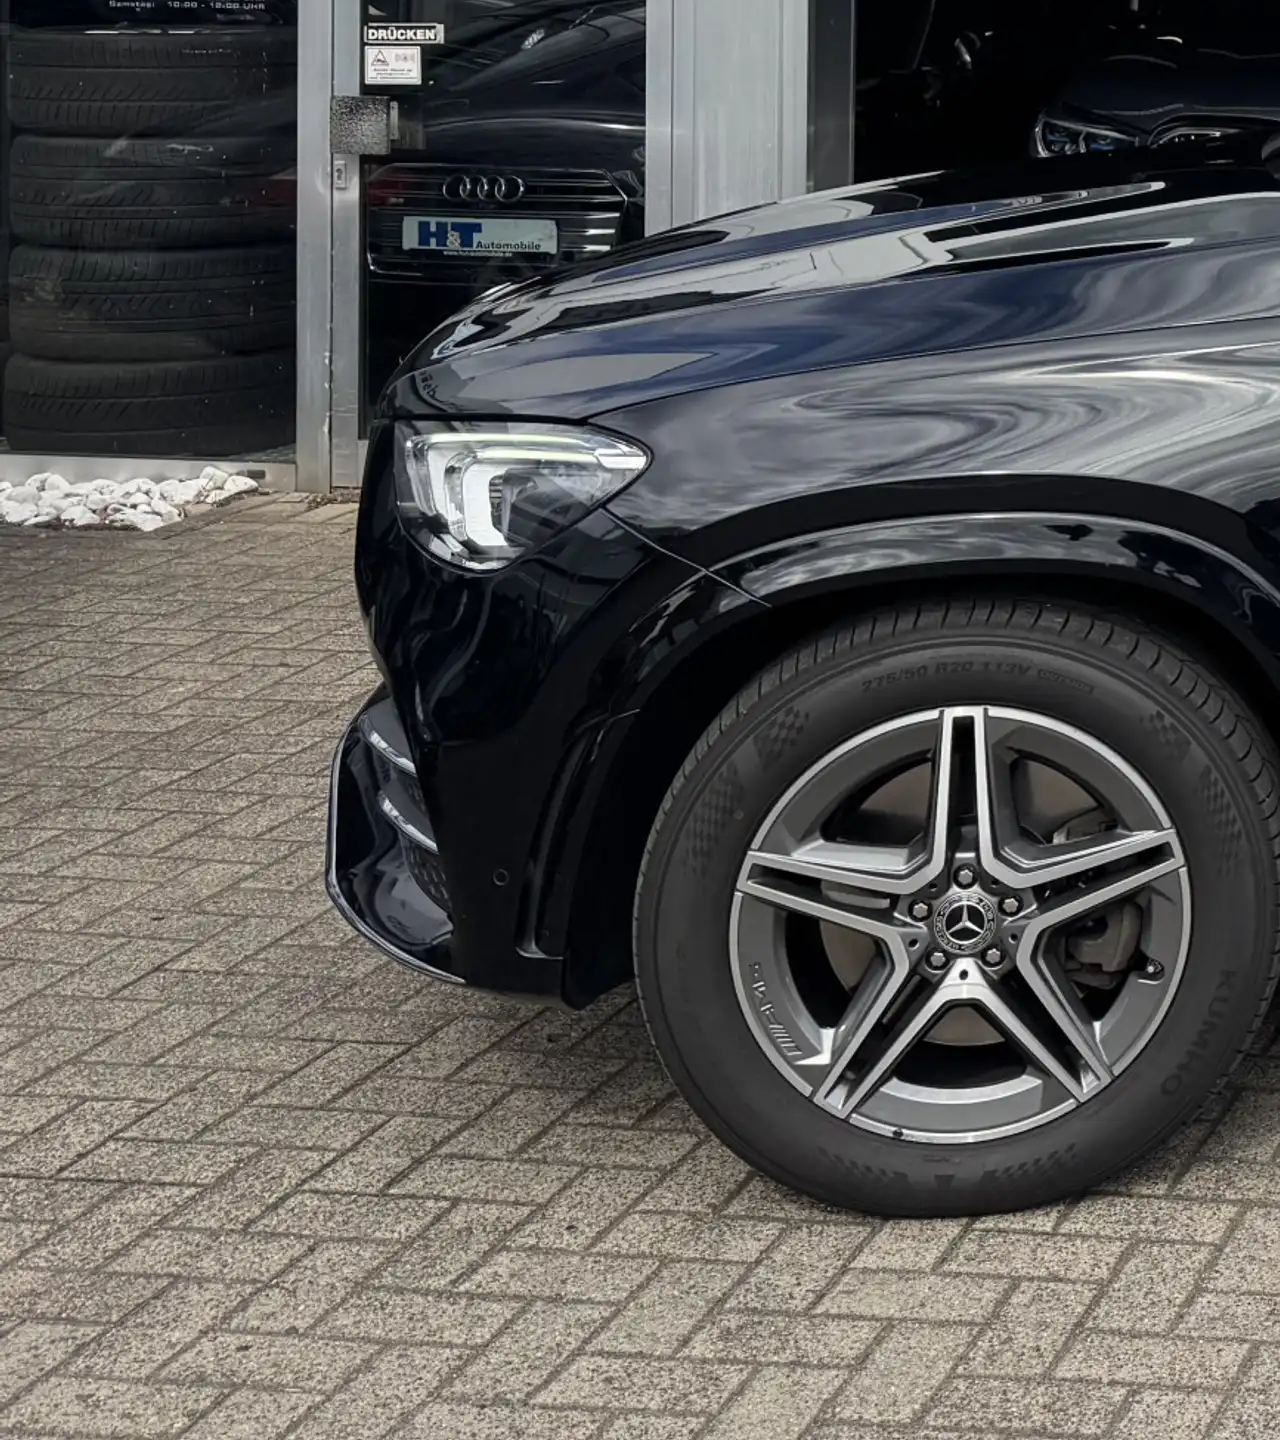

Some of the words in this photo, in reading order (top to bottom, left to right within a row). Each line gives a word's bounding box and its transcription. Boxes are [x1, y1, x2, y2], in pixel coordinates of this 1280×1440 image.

[368, 26, 436, 41] DRÜCKEN
[418, 220, 483, 250] H&T
[475, 240, 542, 252] Automobile
